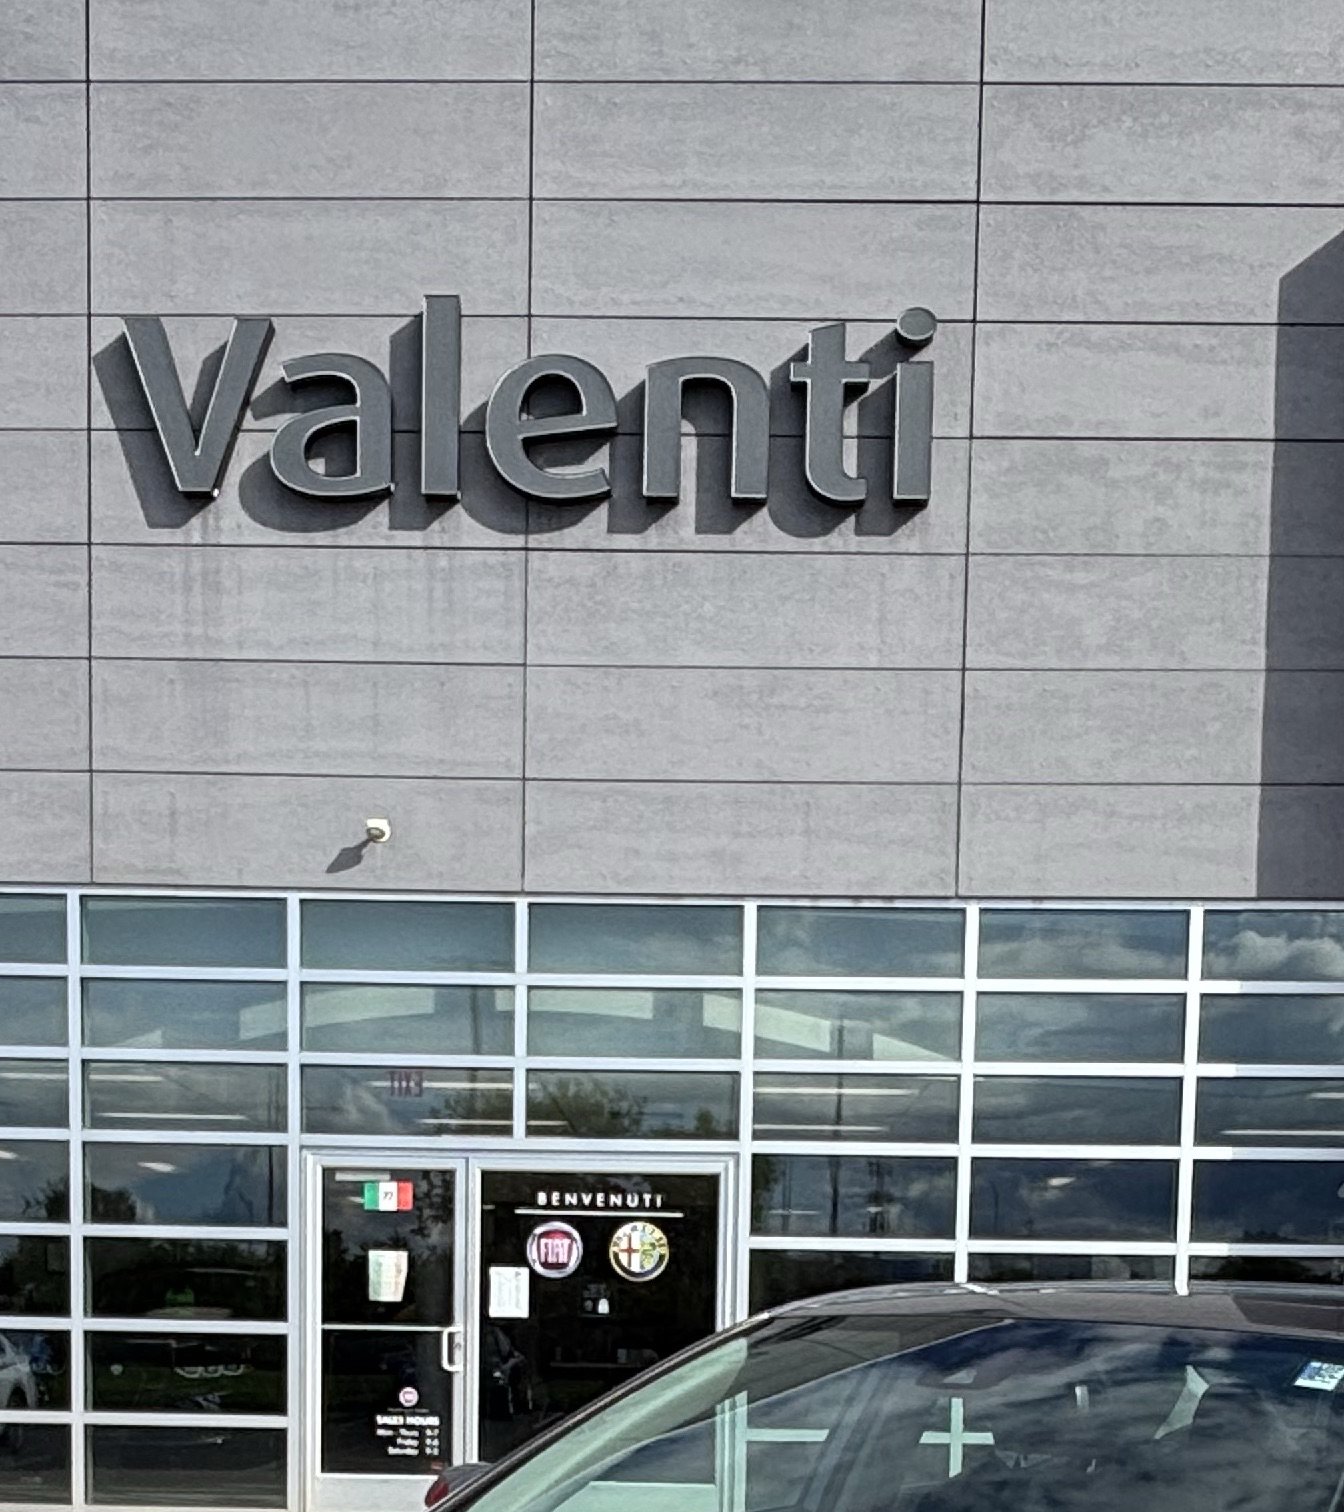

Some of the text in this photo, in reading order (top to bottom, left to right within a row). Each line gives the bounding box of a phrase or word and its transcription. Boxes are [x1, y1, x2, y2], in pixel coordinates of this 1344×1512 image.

[120, 294, 938, 507] Valenti
[536, 1190, 663, 1209] BENVENUTI
[539, 1237, 572, 1264] FIAT
